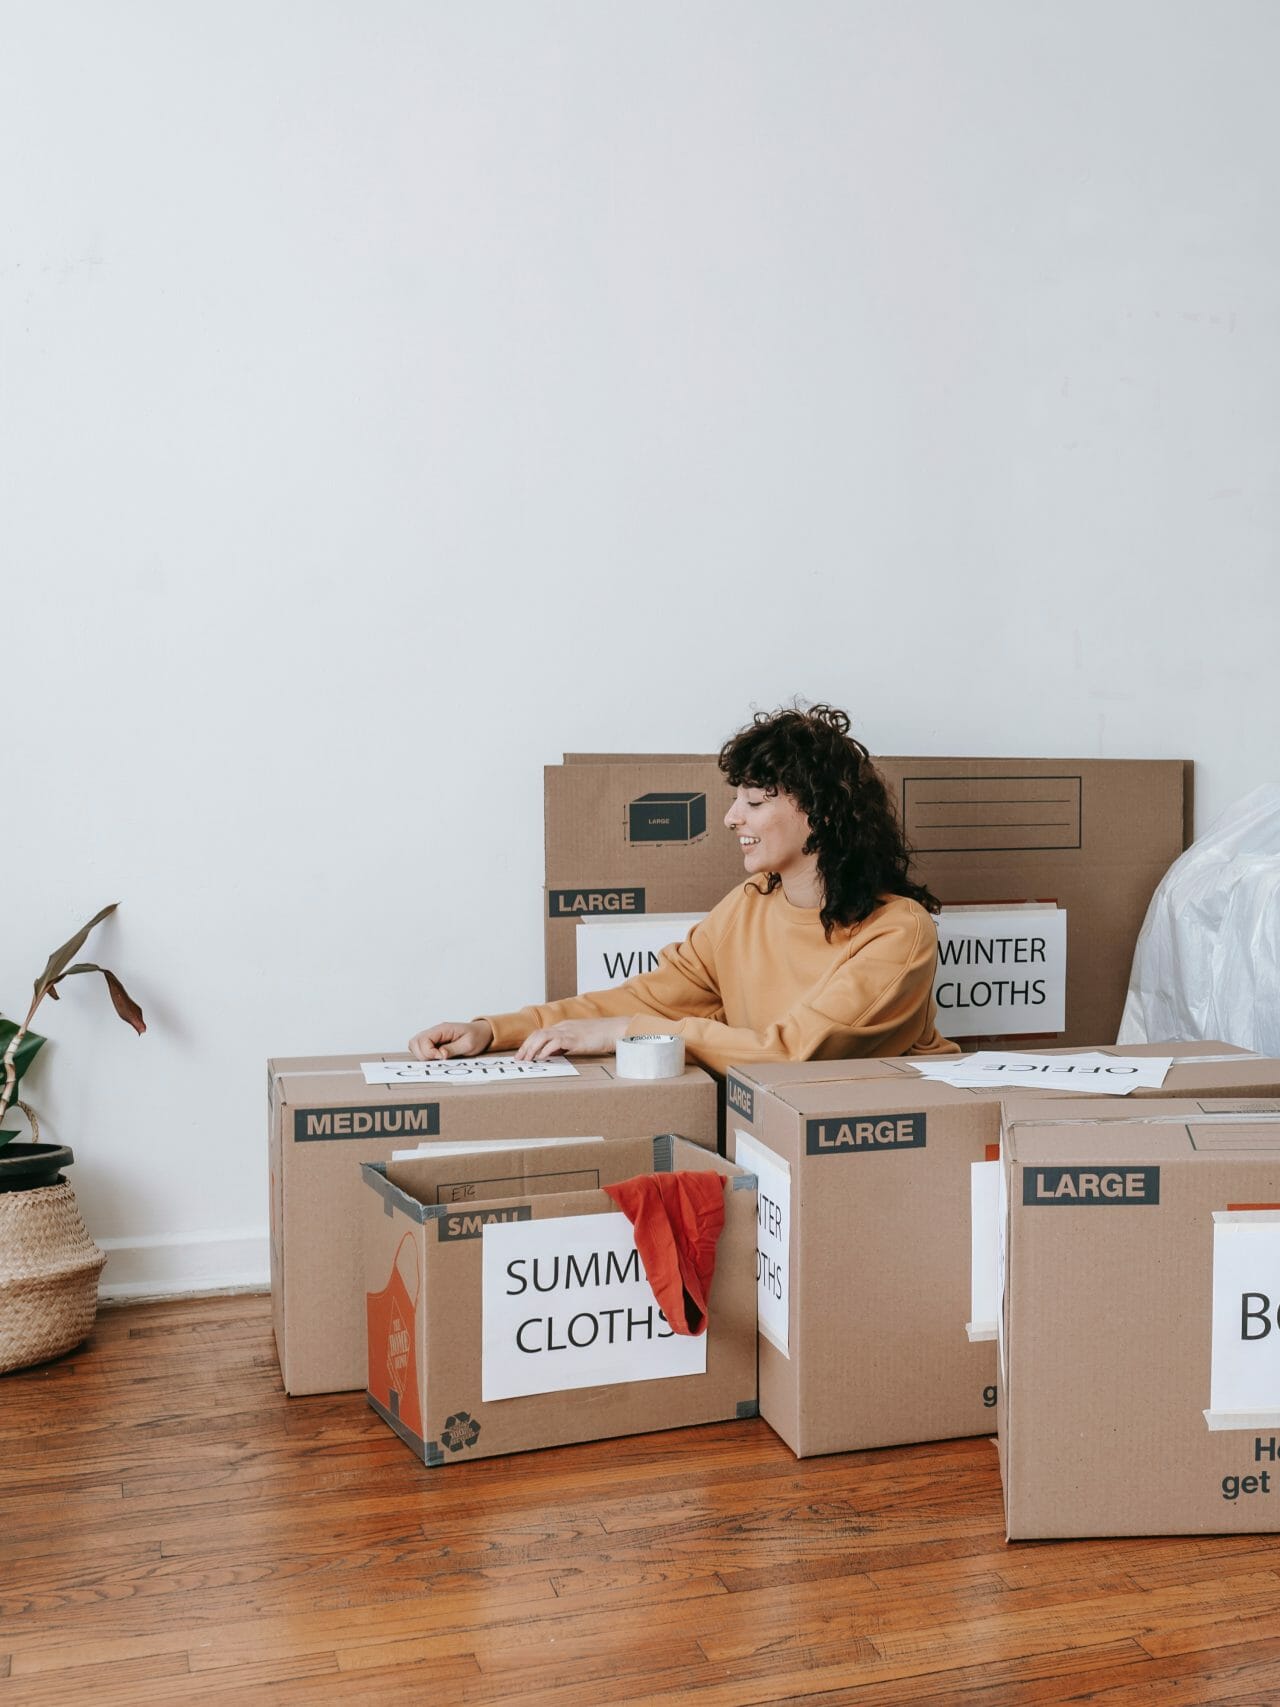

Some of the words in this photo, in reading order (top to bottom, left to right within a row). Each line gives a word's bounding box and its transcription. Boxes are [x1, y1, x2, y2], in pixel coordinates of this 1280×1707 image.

[558, 892, 636, 912] LARGE
[937, 937, 1046, 966] WINTER
[936, 979, 1046, 1009] CLOTHS
[396, 1066, 548, 1077] CLOTHS
[982, 1063, 1139, 1076] OFFICE
[728, 1079, 752, 1114] LARGE
[307, 1109, 428, 1136] MEDIUM
[818, 1119, 914, 1147] LARGE
[1036, 1173, 1146, 1198] LARGE
[506, 1249, 648, 1296] SUMM
[1221, 1471, 1271, 1500] get
